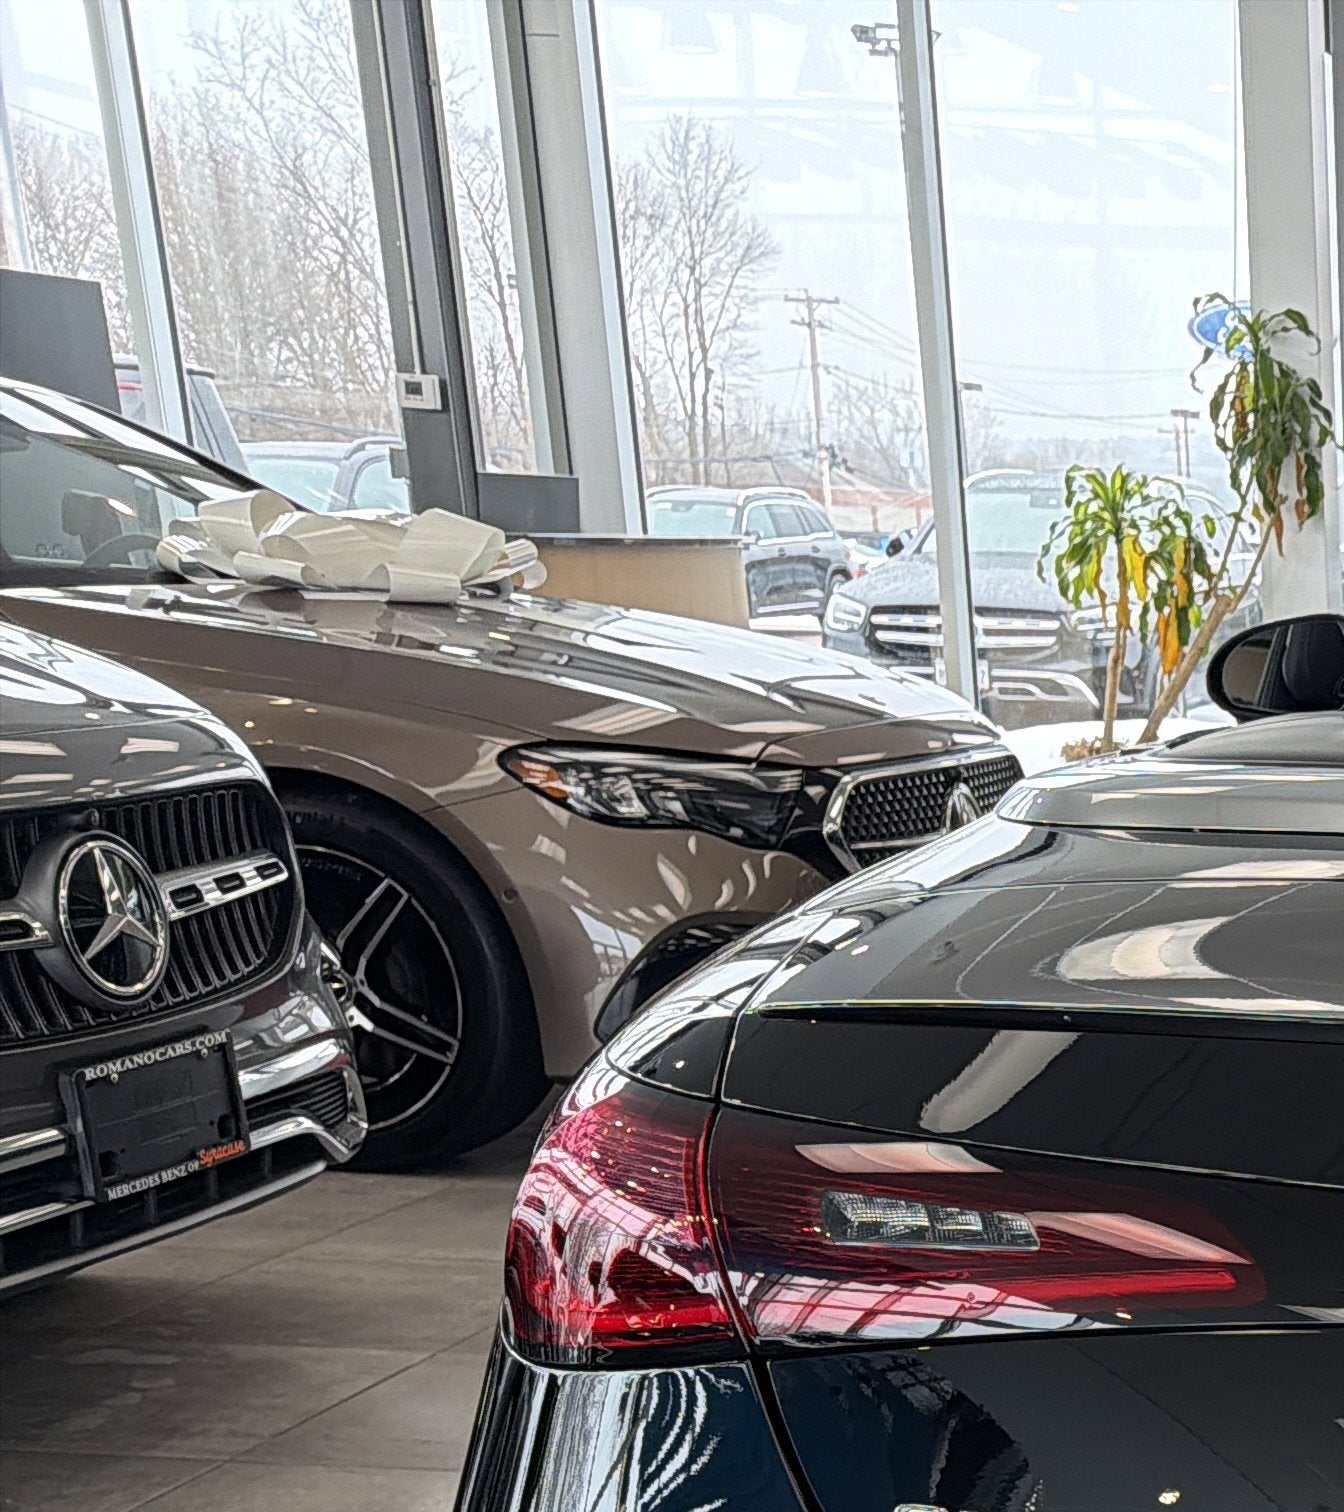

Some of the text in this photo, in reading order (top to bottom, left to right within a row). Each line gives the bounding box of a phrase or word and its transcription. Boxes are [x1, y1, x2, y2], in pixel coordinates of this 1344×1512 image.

[84, 1031, 228, 1082] ROMANOCARS.COM
[106, 1175, 161, 1201] MERCEDES
[161, 1162, 187, 1184] BENZ
